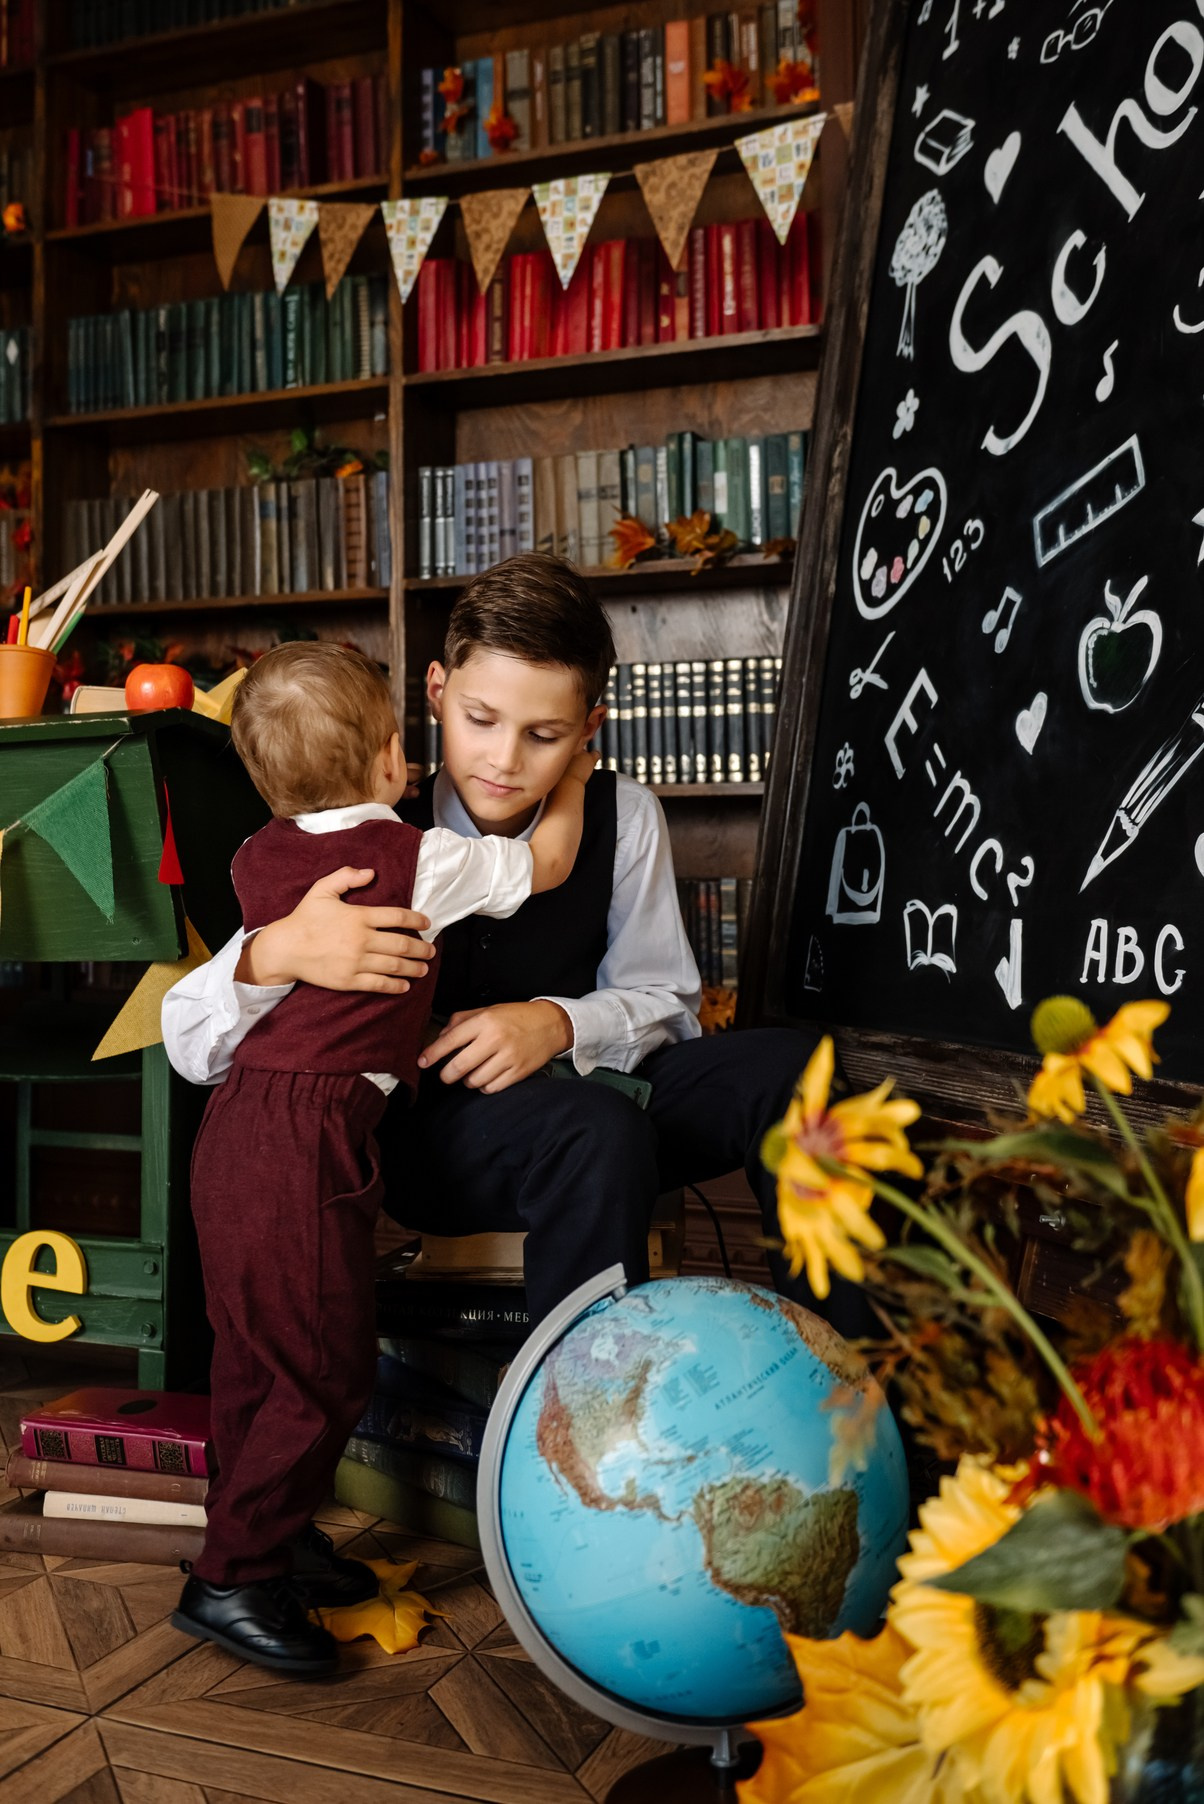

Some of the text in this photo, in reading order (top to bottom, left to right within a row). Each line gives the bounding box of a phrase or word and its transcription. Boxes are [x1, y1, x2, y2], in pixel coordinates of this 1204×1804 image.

[949, 0, 1204, 456] Scho
[941, 517, 986, 585] 123
[1079, 917, 1187, 996] ABC
